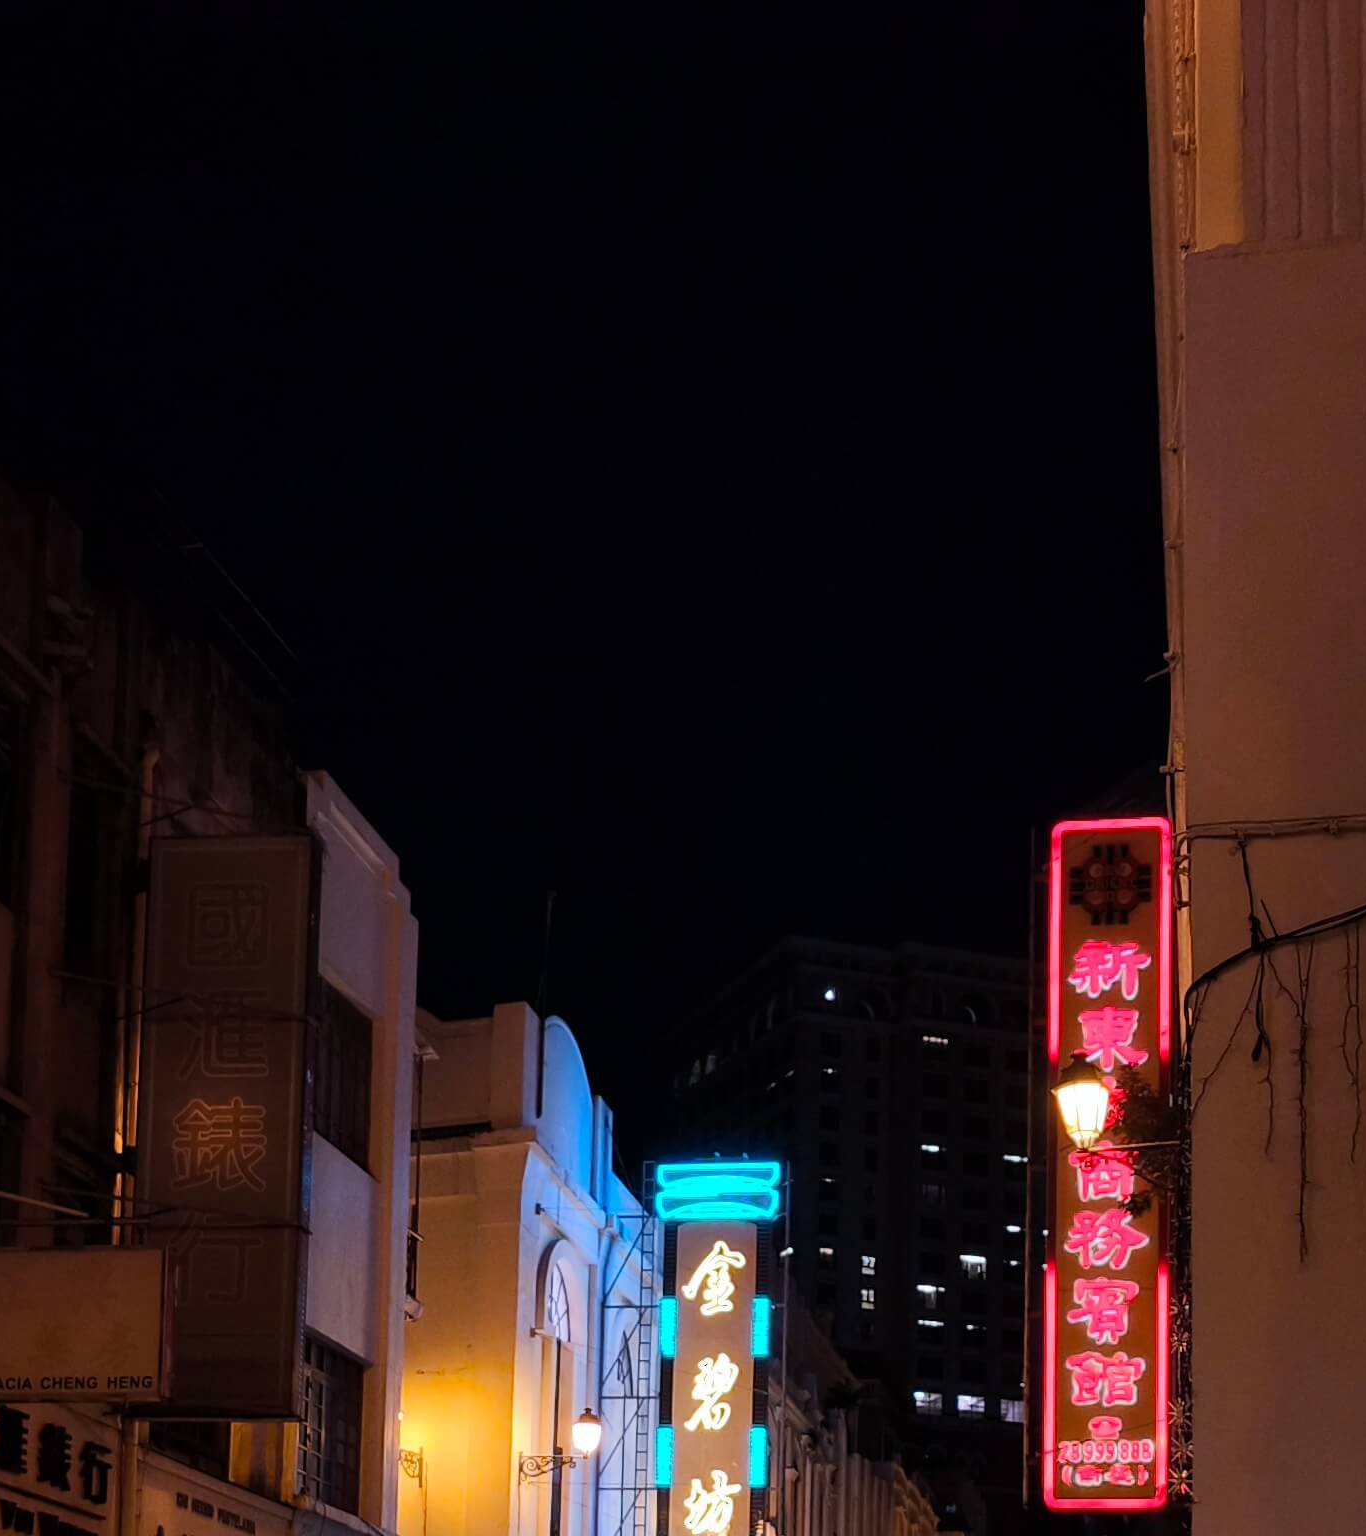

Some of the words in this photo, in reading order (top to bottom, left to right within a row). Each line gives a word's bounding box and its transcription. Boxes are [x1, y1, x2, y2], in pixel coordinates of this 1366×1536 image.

[1064, 940, 1152, 1408] 新東商務賓館
[41, 1375, 98, 1391] CHENG
[107, 1375, 153, 1390] HENG
[681, 1239, 748, 1536] 金碧坊
